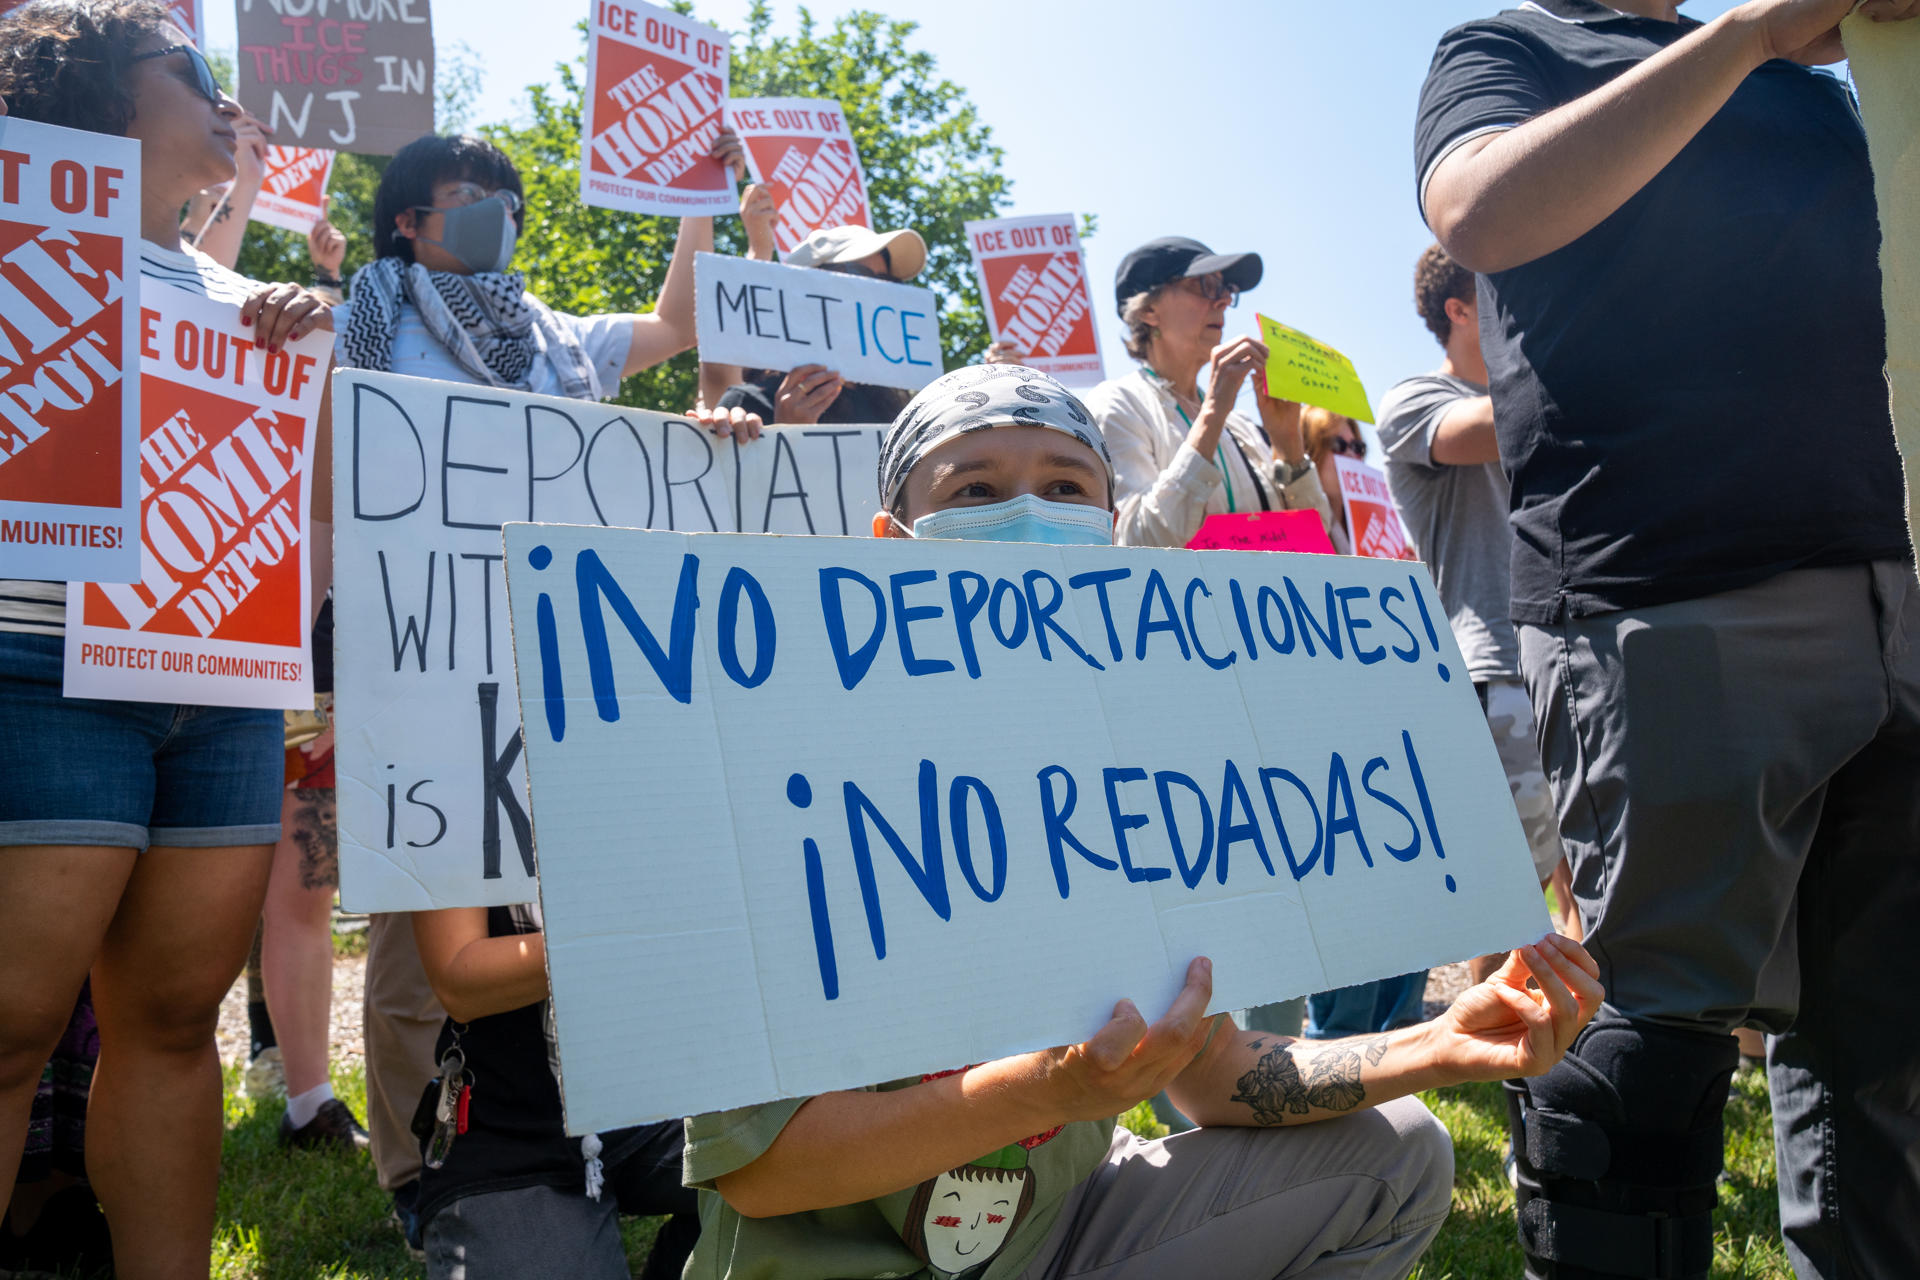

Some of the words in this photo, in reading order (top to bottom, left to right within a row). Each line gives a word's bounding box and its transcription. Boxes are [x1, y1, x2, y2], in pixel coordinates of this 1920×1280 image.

[280, 16, 369, 54] ICE
[597, 0, 637, 37] ICE
[645, 17, 690, 55] OUT
[697, 38, 723, 69] OF
[240, 44, 364, 85] THUGS
[373, 55, 426, 95] IN
[606, 63, 666, 112] THE
[269, 90, 361, 145] NJ
[592, 71, 724, 179] HOME
[732, 110, 771, 131] ICE
[773, 109, 813, 131] OUT
[817, 111, 841, 133] OF
[50, 158, 125, 220] OF
[770, 144, 809, 189] THE
[774, 139, 856, 253] HOME
[820, 179, 864, 229] POT
[974, 230, 1007, 253] ICE
[1010, 226, 1046, 249] OUT
[1051, 224, 1073, 246] OF
[998, 264, 1038, 308] THE
[1000, 252, 1083, 356] HOME
[716, 280, 842, 351] MELT
[856, 301, 933, 367] ICE
[1039, 288, 1089, 357] DEPOT
[174, 319, 254, 387] OUT
[263, 349, 317, 401] OF
[140, 408, 208, 501] HE
[352, 382, 885, 535] DEPORTAT
[96, 406, 304, 632] HOME
[177, 498, 301, 639] DEPOT
[81, 643, 157, 671] PROTECT
[161, 650, 193, 674] OUR
[197, 654, 302, 682] COMMUNITIES!
[528, 545, 777, 743] ¡NO
[819, 566, 1451, 691] DEPORTACIONES!
[387, 763, 447, 848] is
[786, 758, 1009, 1001] ¡NO
[1036, 729, 1458, 900] REDADAS!
